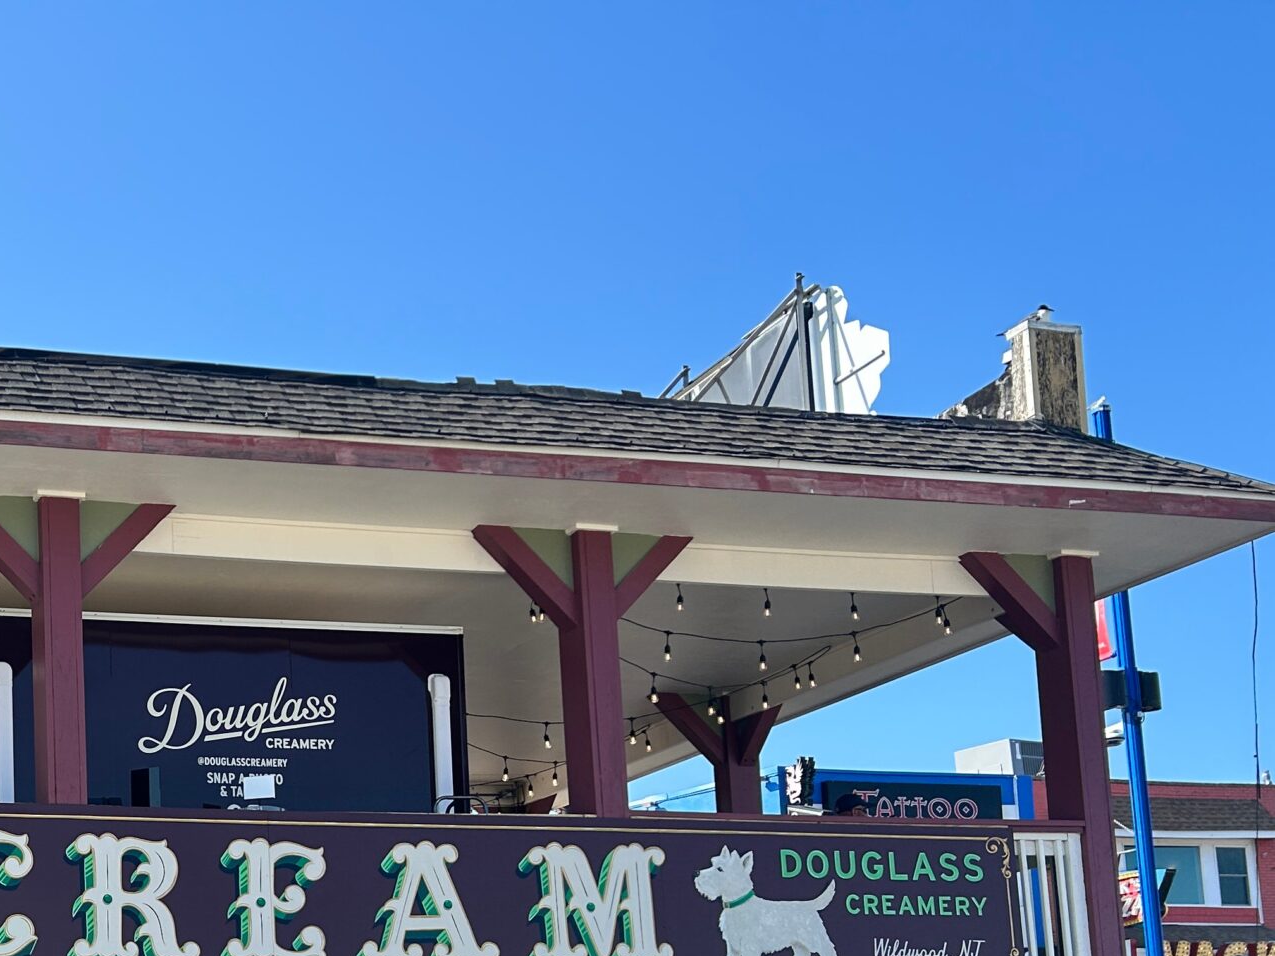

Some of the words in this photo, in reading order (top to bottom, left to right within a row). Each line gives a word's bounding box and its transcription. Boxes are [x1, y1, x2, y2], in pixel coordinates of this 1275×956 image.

[137, 676, 337, 754] Douglass
[265, 737, 335, 751] CREAMERY
[197, 756, 288, 768] @DOUGLASSCREAMERY
[206, 771, 236, 785] SNAP
[238, 772, 245, 785] A
[220, 785, 228, 797] &
[230, 785, 244, 798] TA
[779, 848, 985, 883] DOUGLASS
[845, 893, 988, 917] CREAMERY
